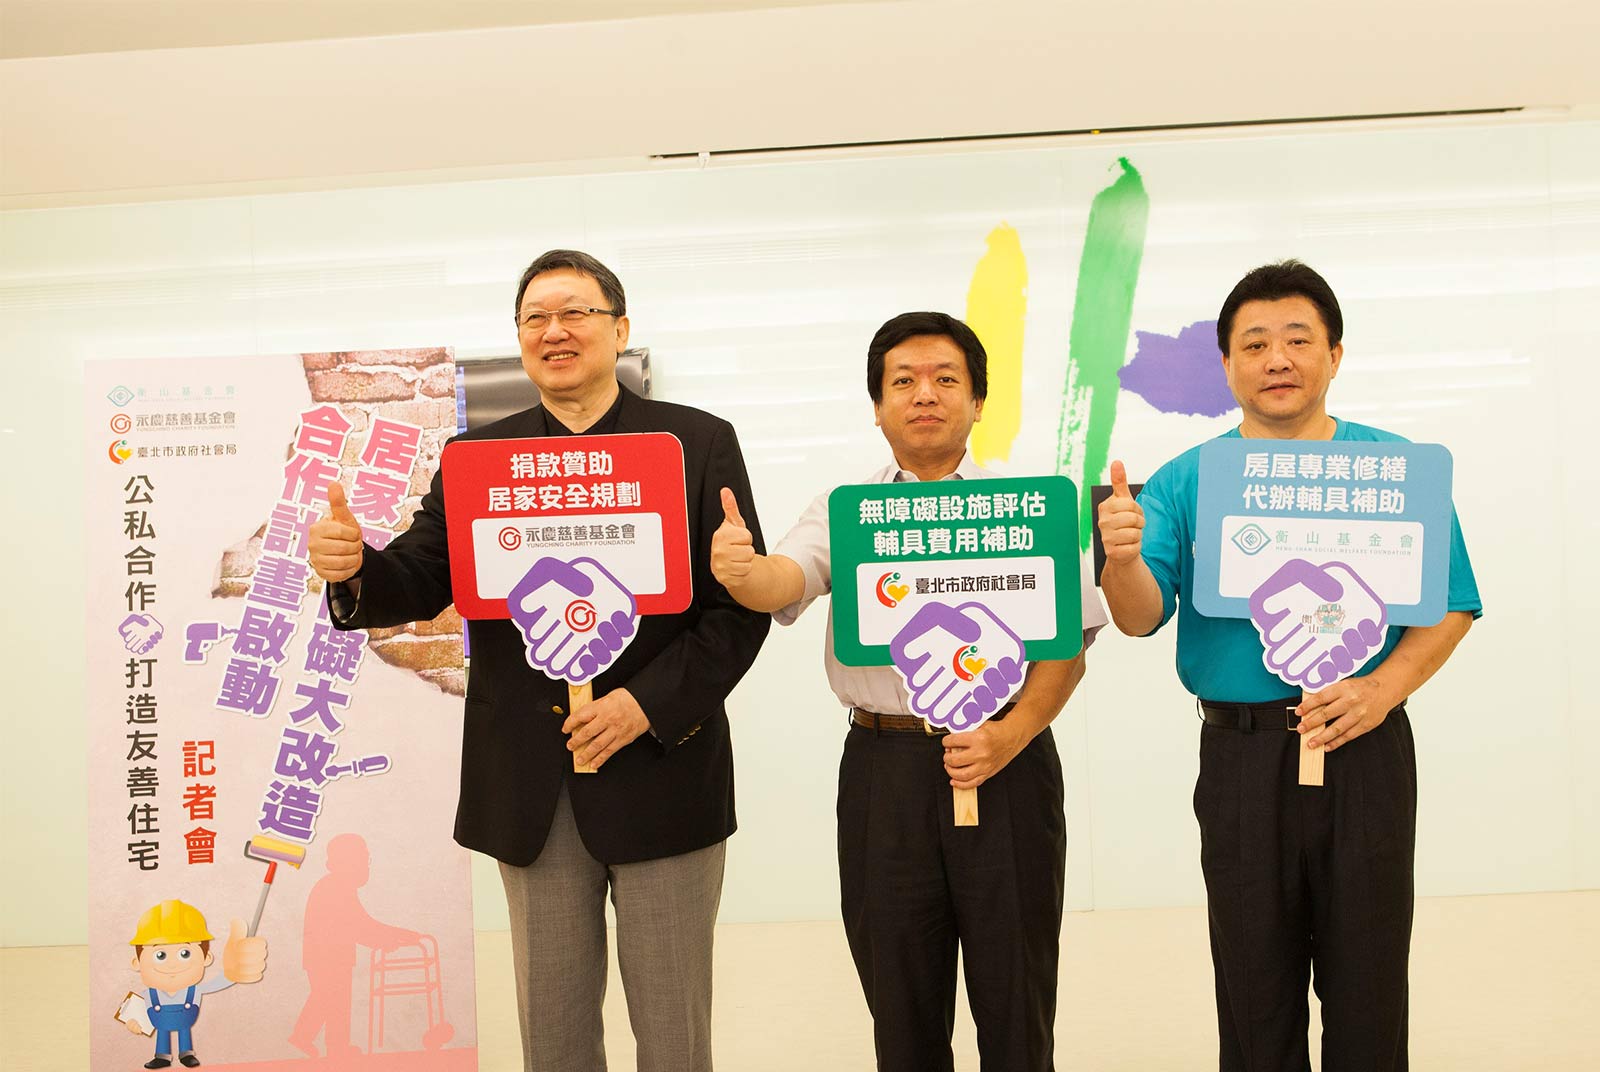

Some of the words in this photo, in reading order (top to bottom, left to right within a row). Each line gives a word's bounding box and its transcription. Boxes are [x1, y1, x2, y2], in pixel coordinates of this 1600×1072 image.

[135, 411, 236, 427] 永慶慈善基金會
[137, 443, 237, 458] 臺北市政府社會局
[510, 450, 613, 479] 捐款贊助
[1242, 452, 1408, 482] 房屋專業修繕
[488, 481, 642, 512] 居家安全規劃
[858, 491, 1046, 525] 無障礙設施評估
[1242, 484, 1405, 514] 代辦輔具補助
[123, 475, 156, 612] 公私合作
[525, 523, 636, 542] 永慶慈善基金會
[526, 541, 564, 549] YUNGCHING
[873, 525, 1034, 557] 輔具費用補助
[1275, 530, 1414, 548] 衡山基金會
[915, 574, 1036, 595] 臺北市政府社會局
[258, 416, 424, 841] 居家礙大改造
[125, 657, 160, 872] 打造友善住宅
[182, 740, 217, 865] 記者會
